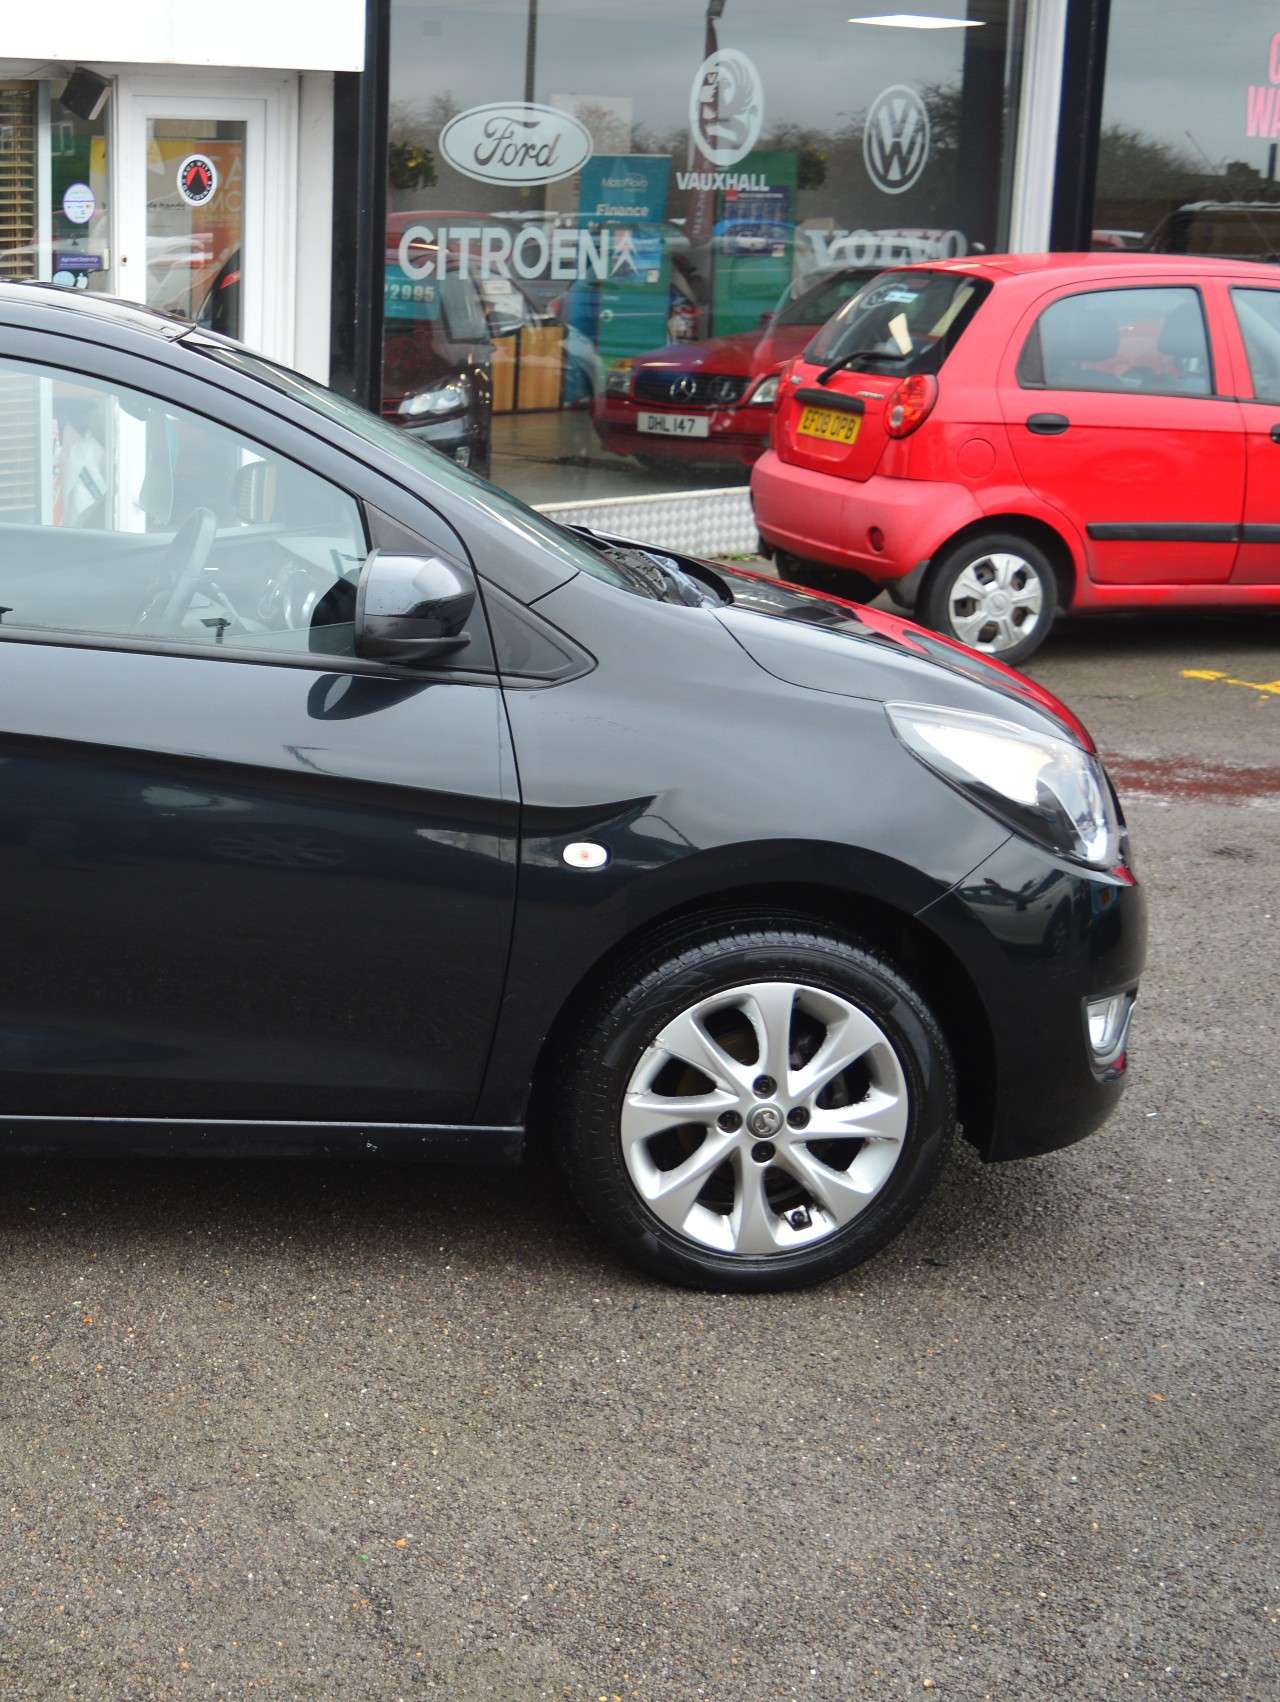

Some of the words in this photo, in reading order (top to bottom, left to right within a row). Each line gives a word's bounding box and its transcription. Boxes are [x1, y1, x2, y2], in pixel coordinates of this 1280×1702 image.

[473, 116, 561, 168] Ford
[675, 171, 770, 191] VAUXHALL
[596, 203, 649, 217] Finance
[397, 218, 610, 281] CITROËN
[804, 228, 968, 268] VOLVO
[673, 416, 696, 433] 147
